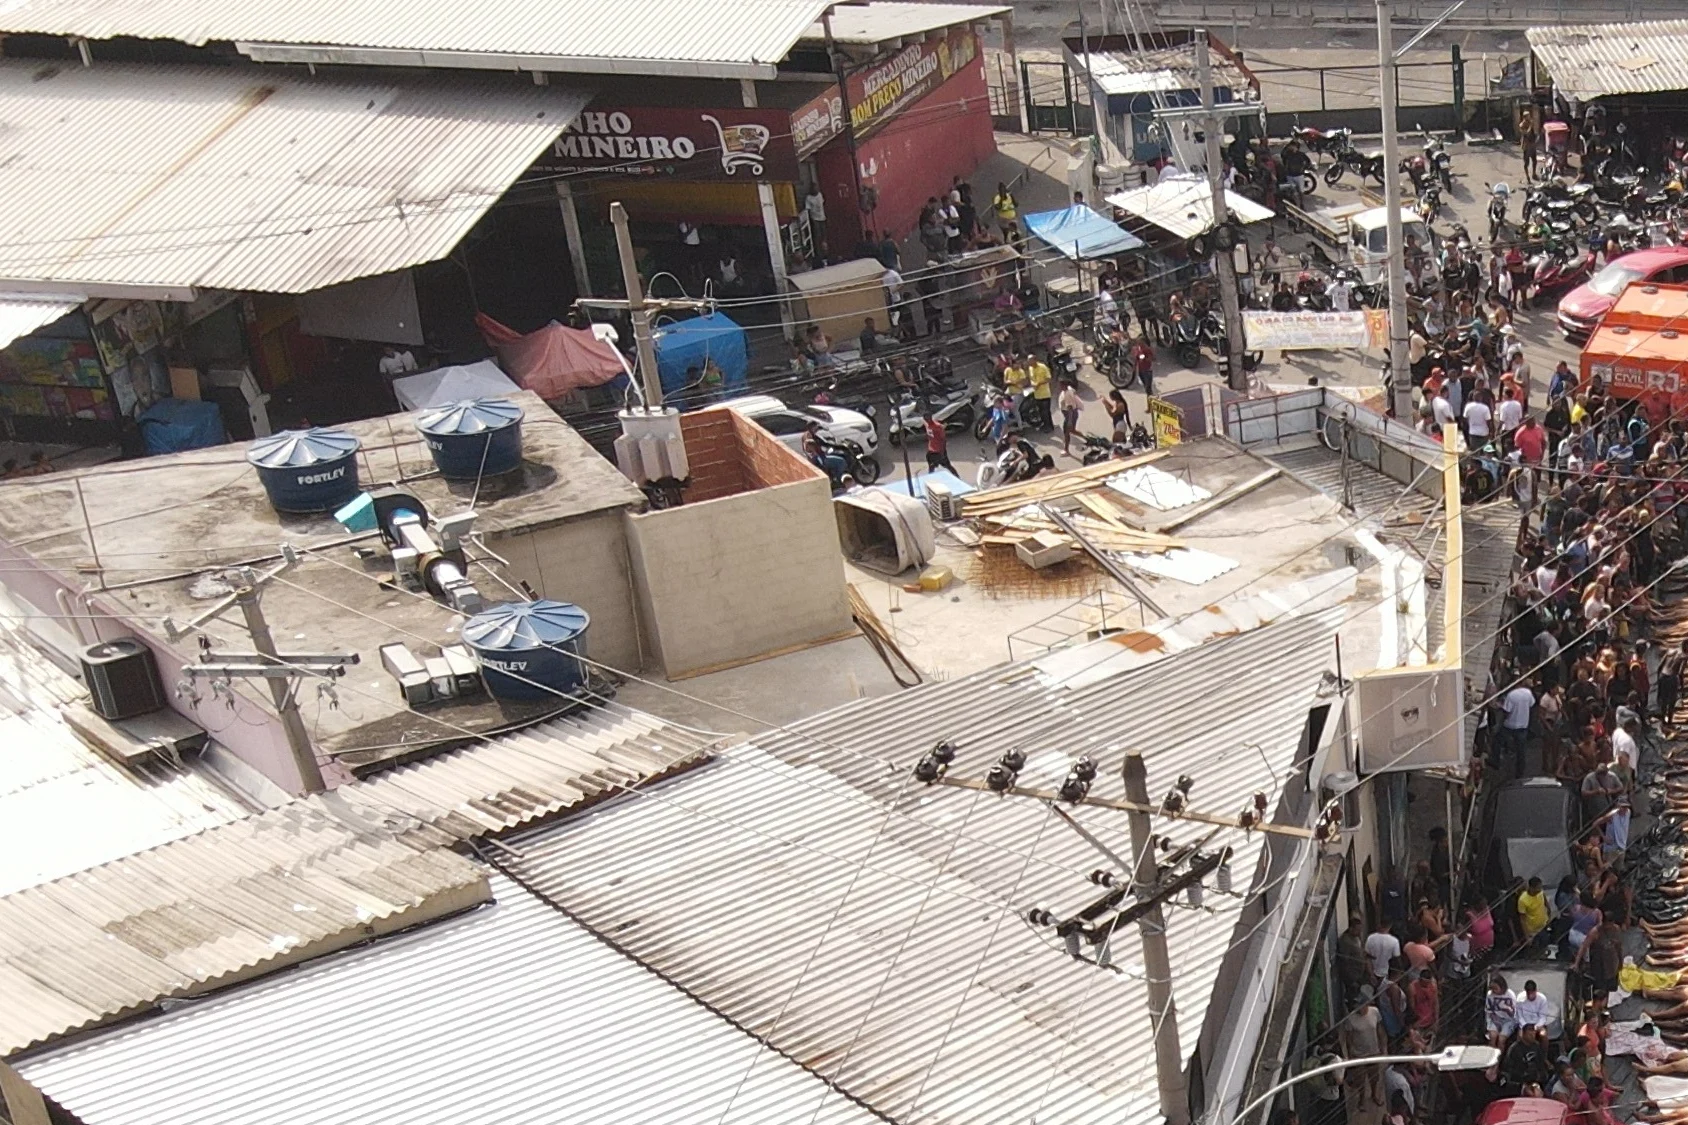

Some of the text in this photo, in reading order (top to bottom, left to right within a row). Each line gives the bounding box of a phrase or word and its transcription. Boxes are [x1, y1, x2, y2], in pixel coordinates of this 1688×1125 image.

[555, 136, 695, 160] MINEIRO
[1614, 371, 1645, 385] CIVIL
[1647, 370, 1680, 393] RJ
[297, 466, 346, 486] FORTLEV
